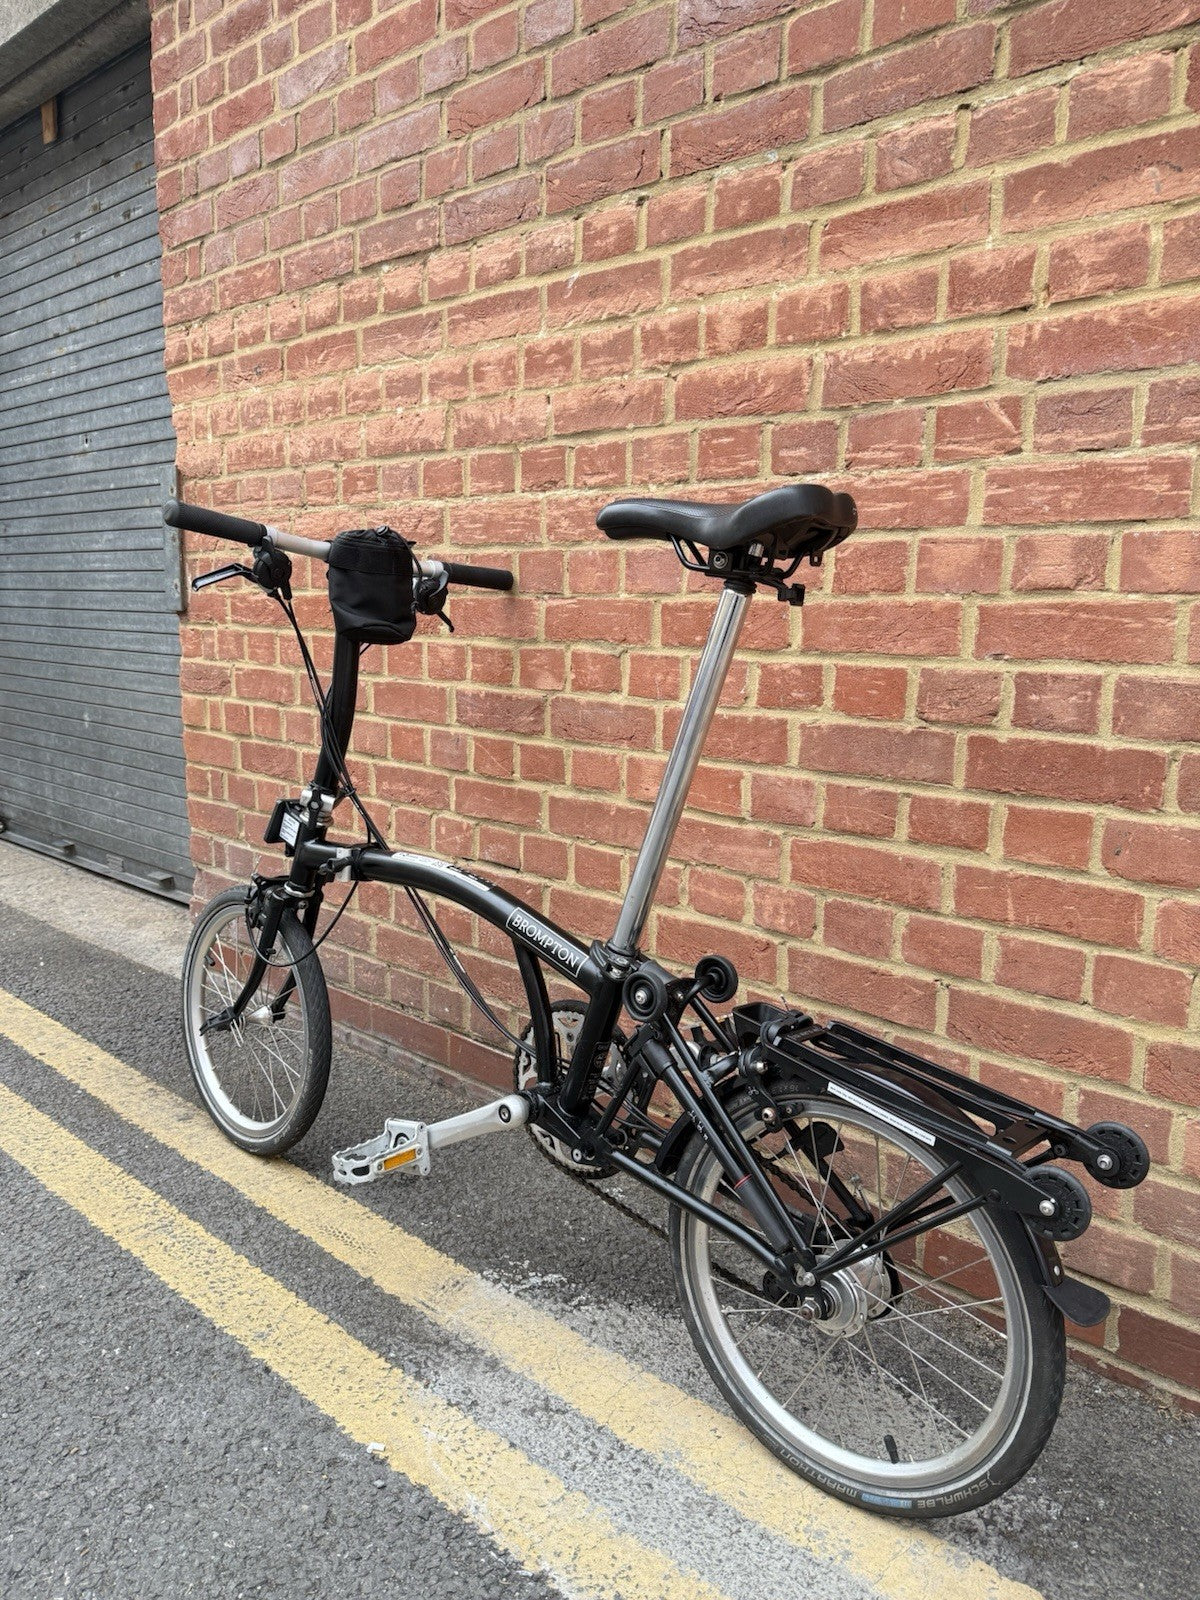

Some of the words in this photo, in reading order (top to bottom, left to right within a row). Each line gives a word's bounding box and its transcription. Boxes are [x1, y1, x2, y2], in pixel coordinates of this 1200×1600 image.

[512, 914, 579, 968] BROMPTON
[779, 1449, 857, 1498] MARATHON
[917, 1479, 989, 1509] SCHWALBE
